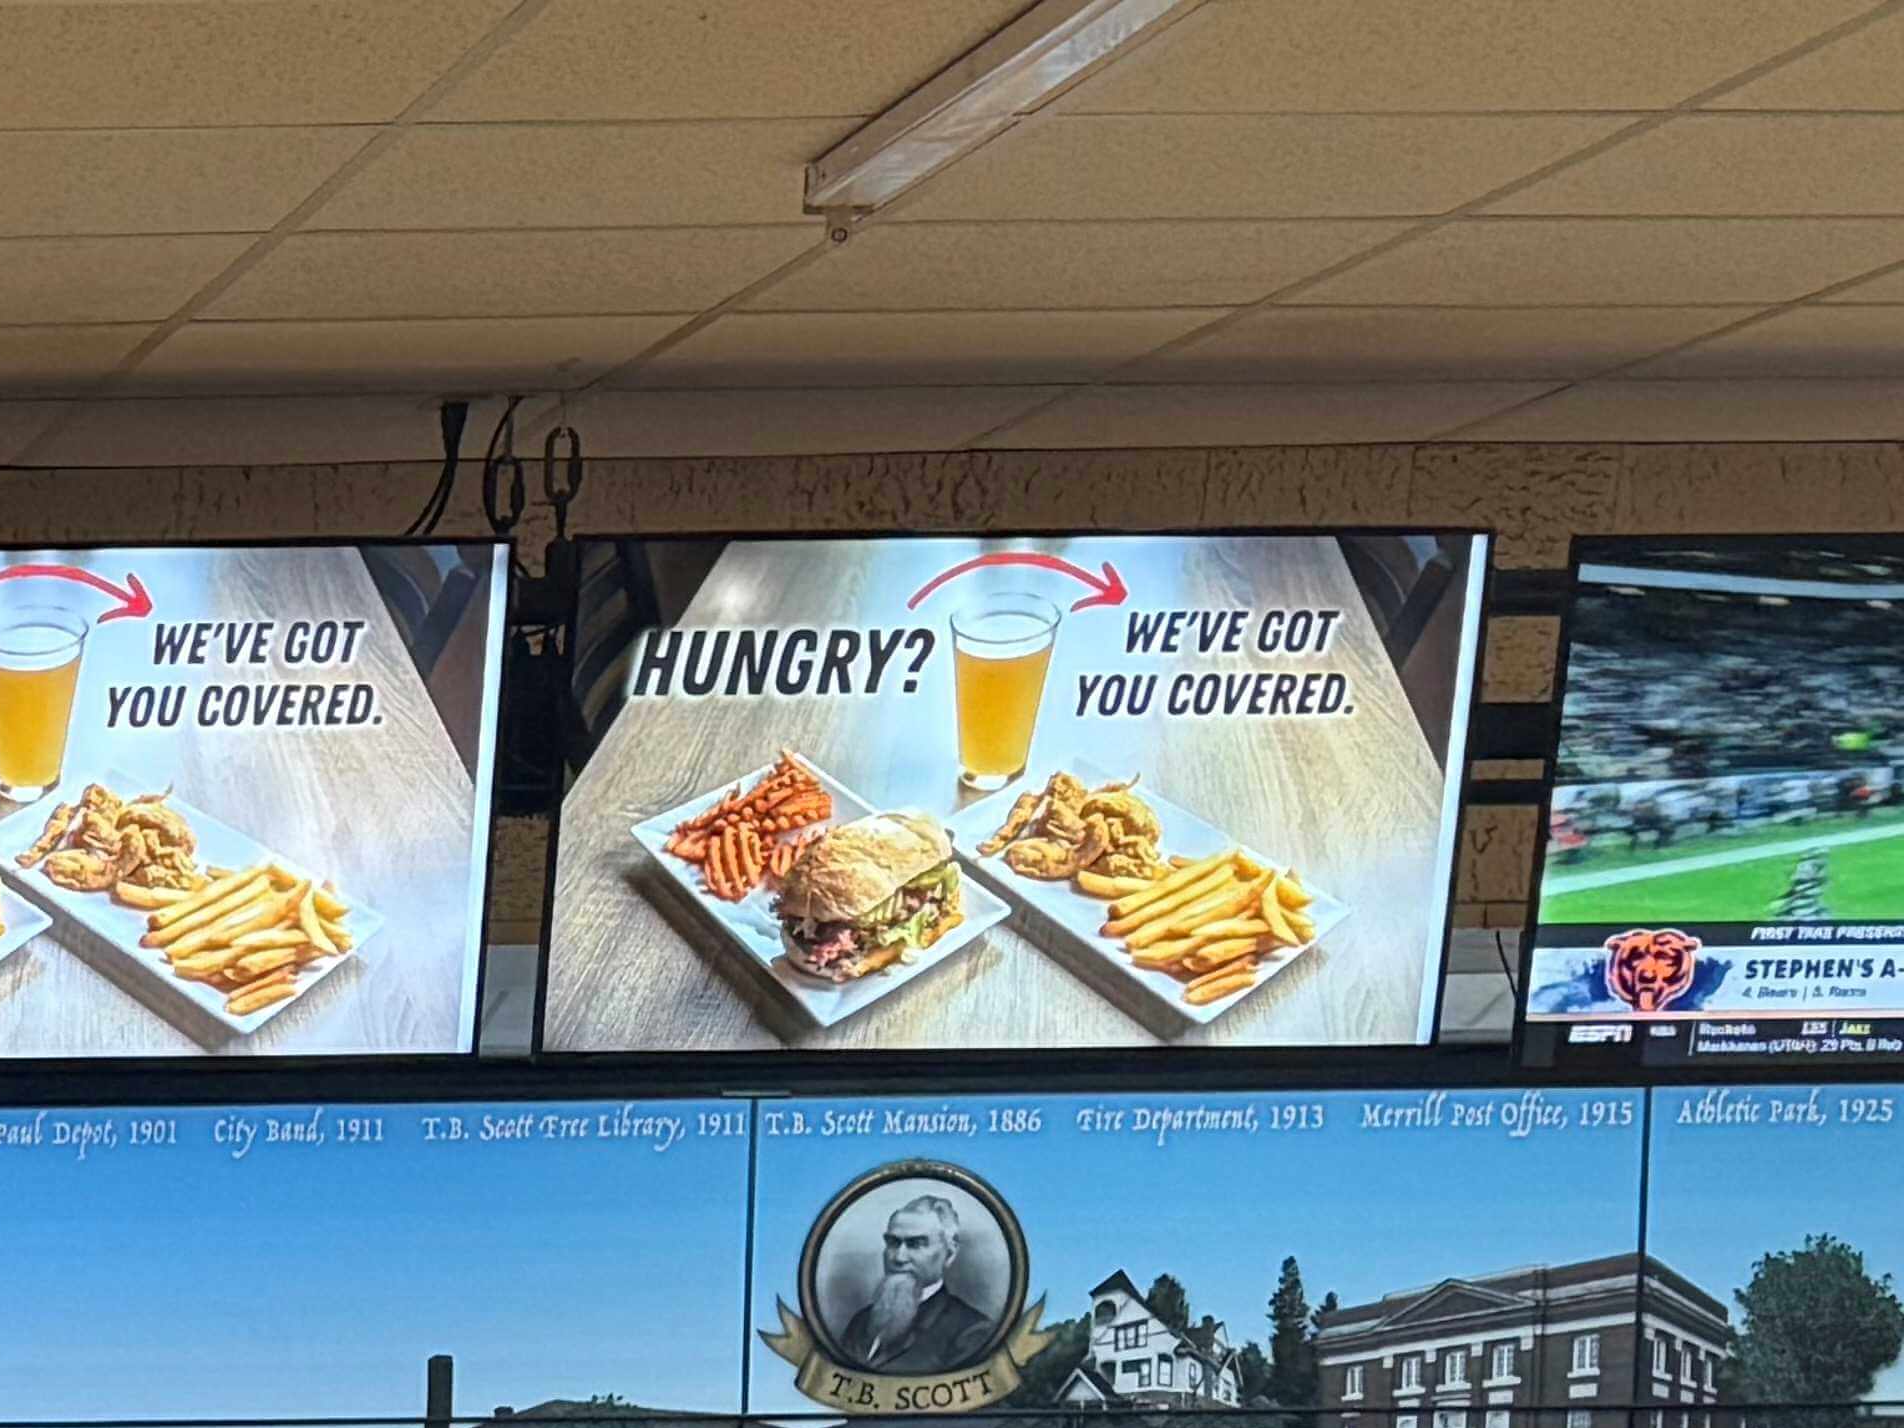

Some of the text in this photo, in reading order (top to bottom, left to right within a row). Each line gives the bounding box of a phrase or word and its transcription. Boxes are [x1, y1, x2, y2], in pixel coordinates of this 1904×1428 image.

[153, 620, 366, 665] WE'VE GOT
[1123, 609, 1341, 654] WE'VE GOT
[633, 627, 937, 697] HUNGRY?
[105, 684, 384, 728] YOU COVERED.
[1076, 672, 1357, 717] YOU COVERED.
[1745, 958, 1875, 980] STEPHEN'S
[1568, 1025, 1633, 1044] ESPN
[422, 1103, 746, 1153] T.B. Scott Free Library, 1911
[764, 1104, 1043, 1138] T.B. Scott Mansion, 1886
[1076, 1103, 1325, 1147] Fire Department, 1913
[1360, 1091, 1633, 1137] Merrill Post Office, 1915
[1676, 1089, 1894, 1127] Athletic Park, 1925
[128, 1119, 178, 1145] 1901
[213, 1106, 384, 1159] City Band, 1911
[831, 1369, 993, 1411] T.B. SCOTT
